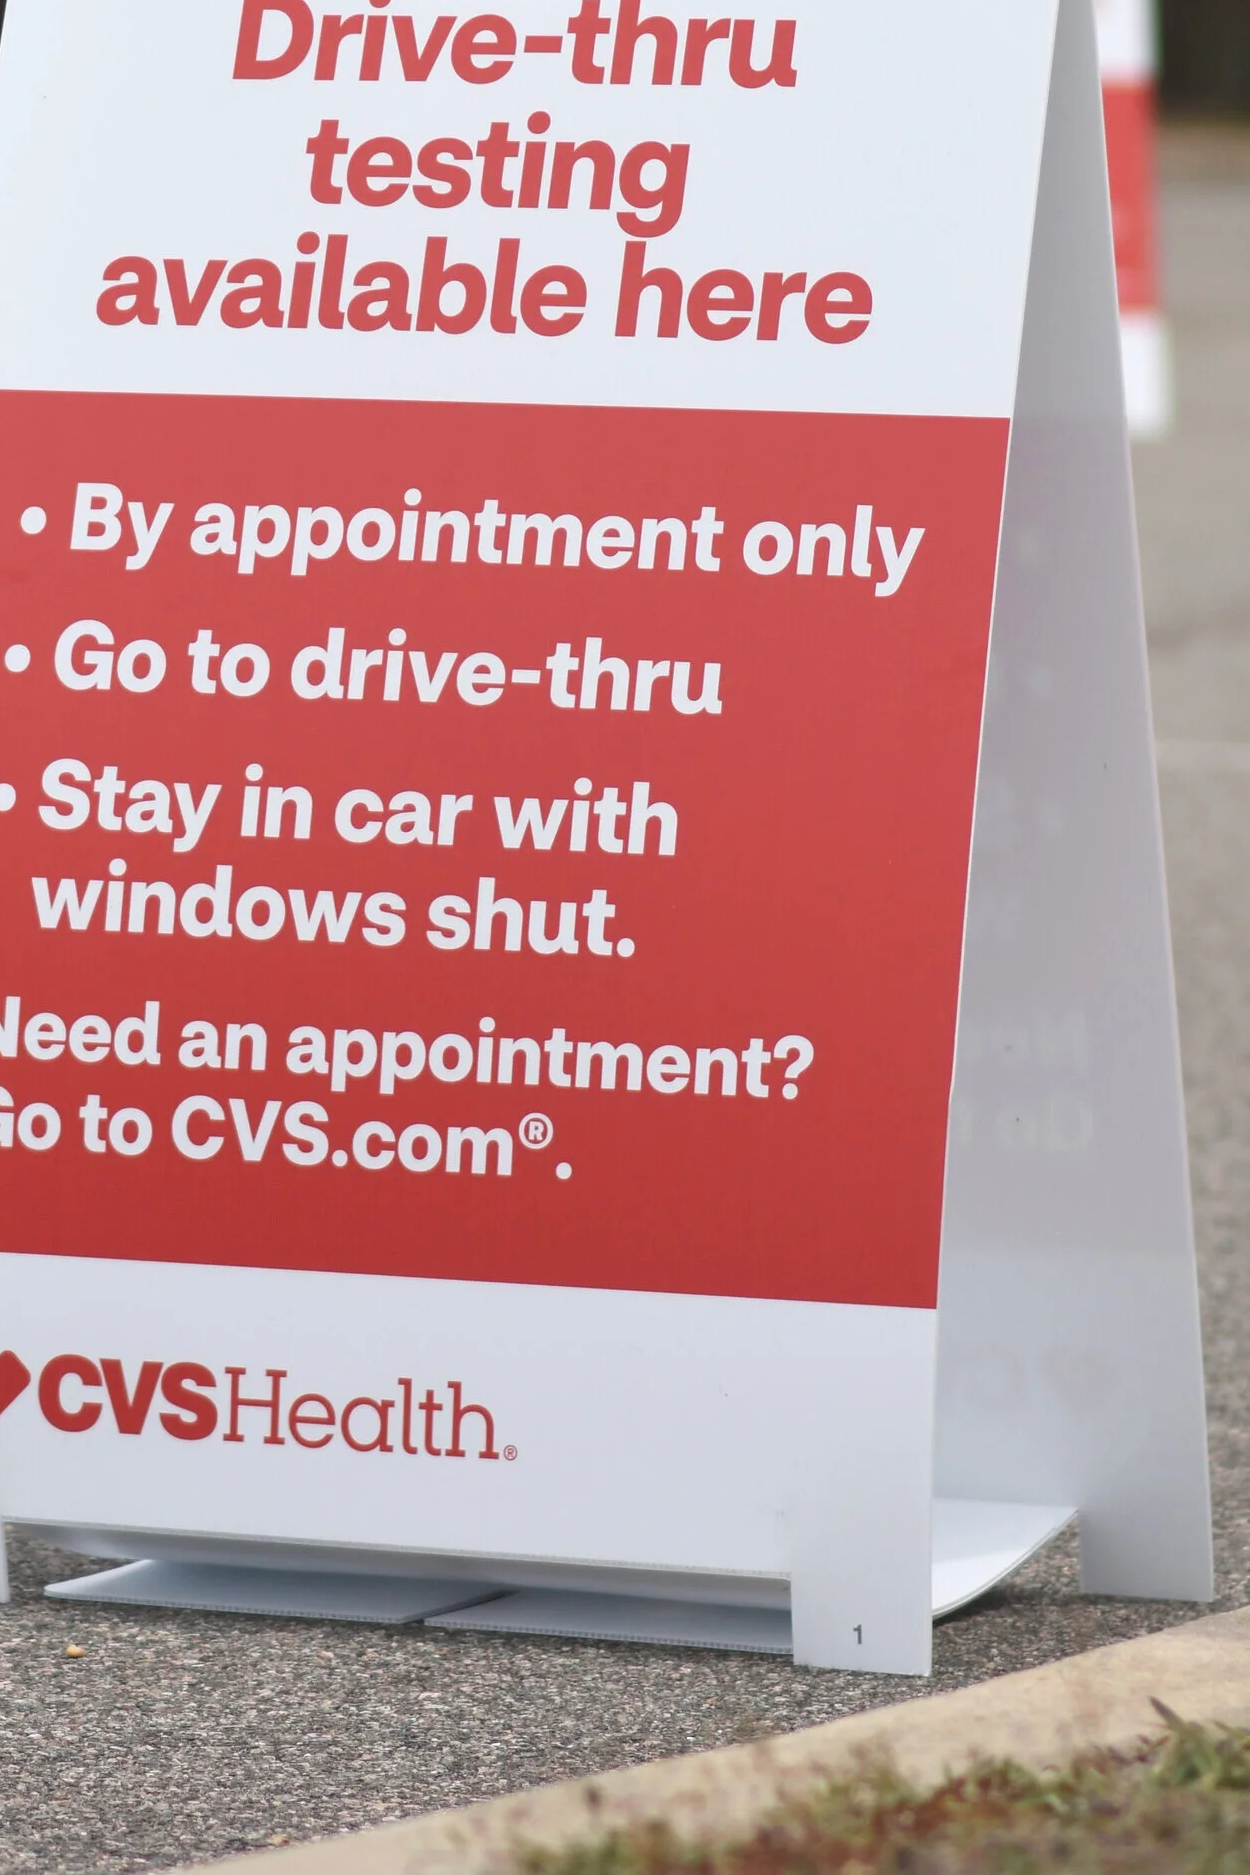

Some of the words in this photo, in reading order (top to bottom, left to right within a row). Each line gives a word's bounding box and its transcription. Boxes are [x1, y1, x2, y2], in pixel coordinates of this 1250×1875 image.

[306, 110, 690, 238] testing
[96, 231, 587, 338] available
[615, 240, 873, 344] here
[69, 482, 175, 571] By
[189, 487, 725, 577] appointment
[742, 504, 926, 597] only
[54, 619, 167, 693] Go
[187, 629, 271, 697] to
[290, 627, 723, 715] drive-thru
[38, 758, 223, 853] Stay
[240, 763, 313, 840] in
[334, 788, 474, 846] car
[493, 777, 678, 856] with
[31, 858, 407, 947] windows
[426, 876, 636, 958] shut.
[178, 1020, 267, 1071] an
[285, 1016, 815, 1100] appointment?
[79, 1094, 153, 1156] to
[852, 1623, 863, 1645] 1
